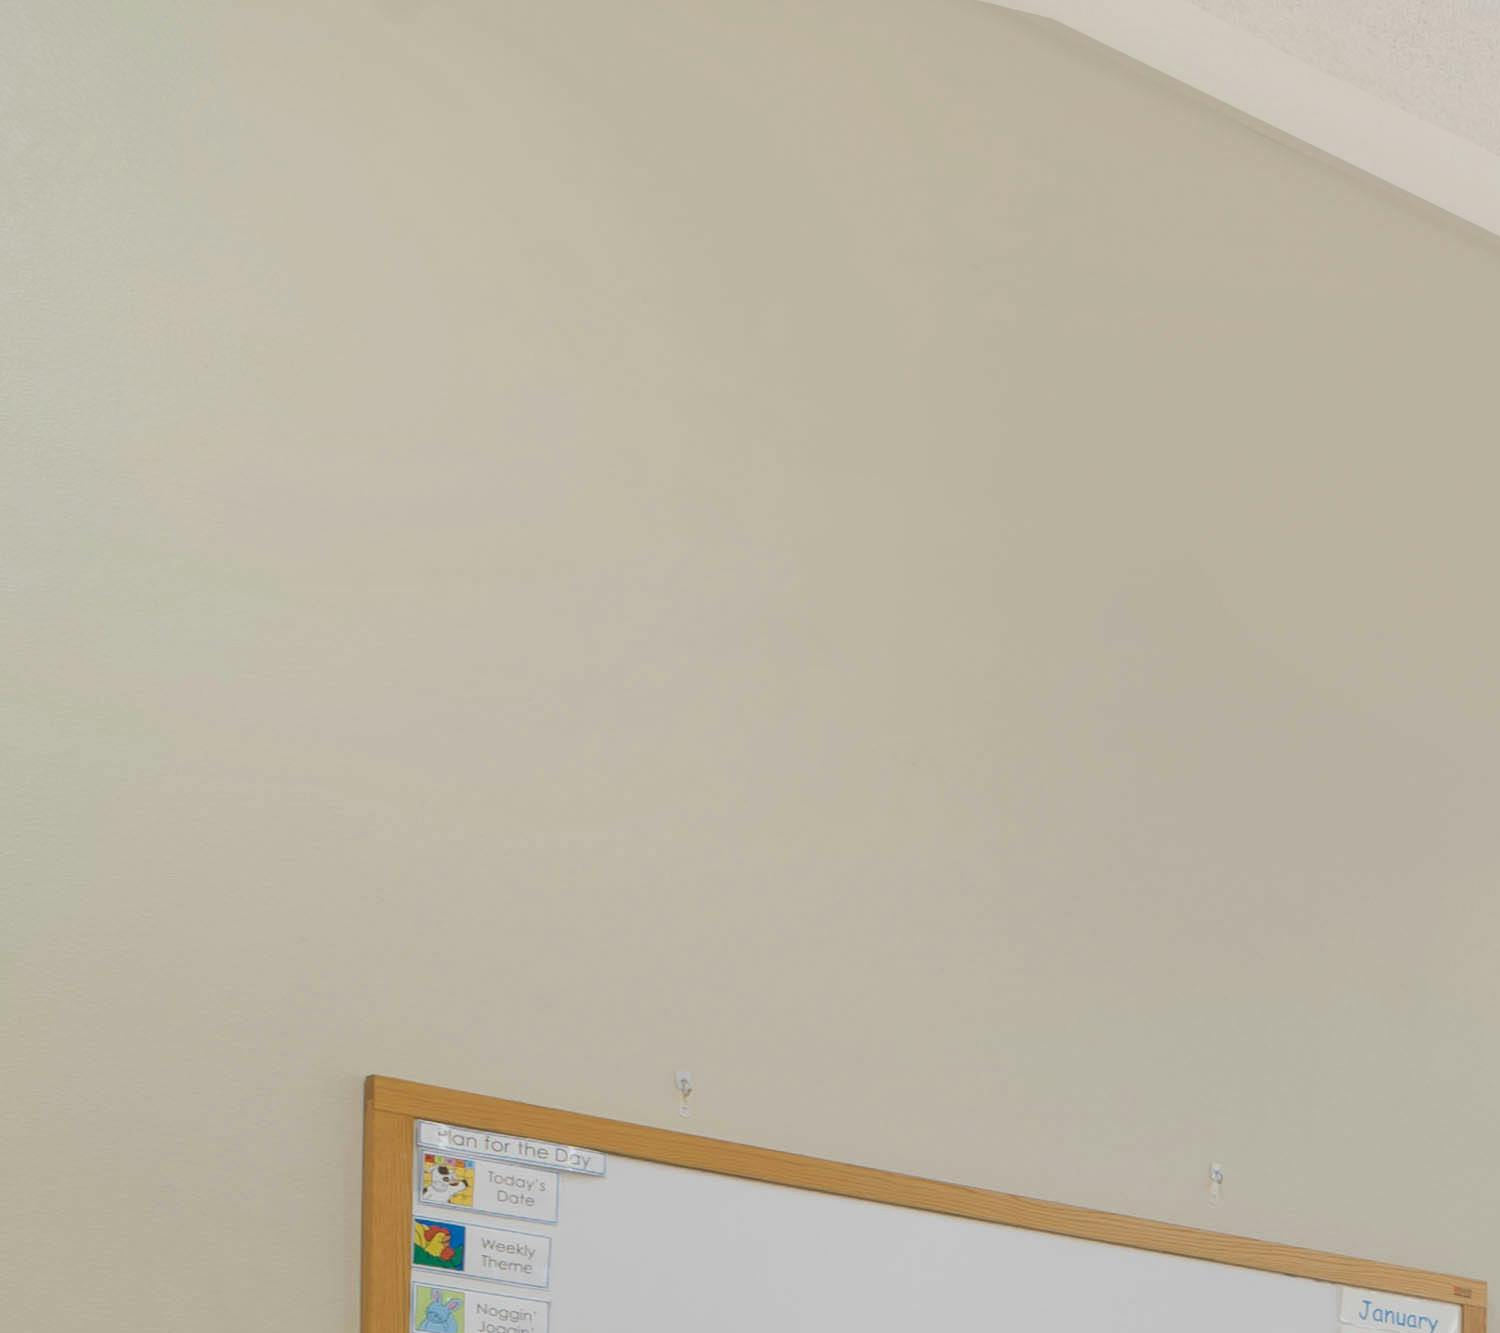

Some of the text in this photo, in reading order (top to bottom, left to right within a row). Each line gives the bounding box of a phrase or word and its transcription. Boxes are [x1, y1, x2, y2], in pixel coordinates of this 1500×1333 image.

[438, 1129, 591, 1169] lan for the Day
[488, 1170, 546, 1192] Today's
[497, 1190, 535, 1207] Date
[481, 1237, 536, 1259] Weekly
[481, 1254, 533, 1274] Theme
[476, 1303, 536, 1323] Noggin'
